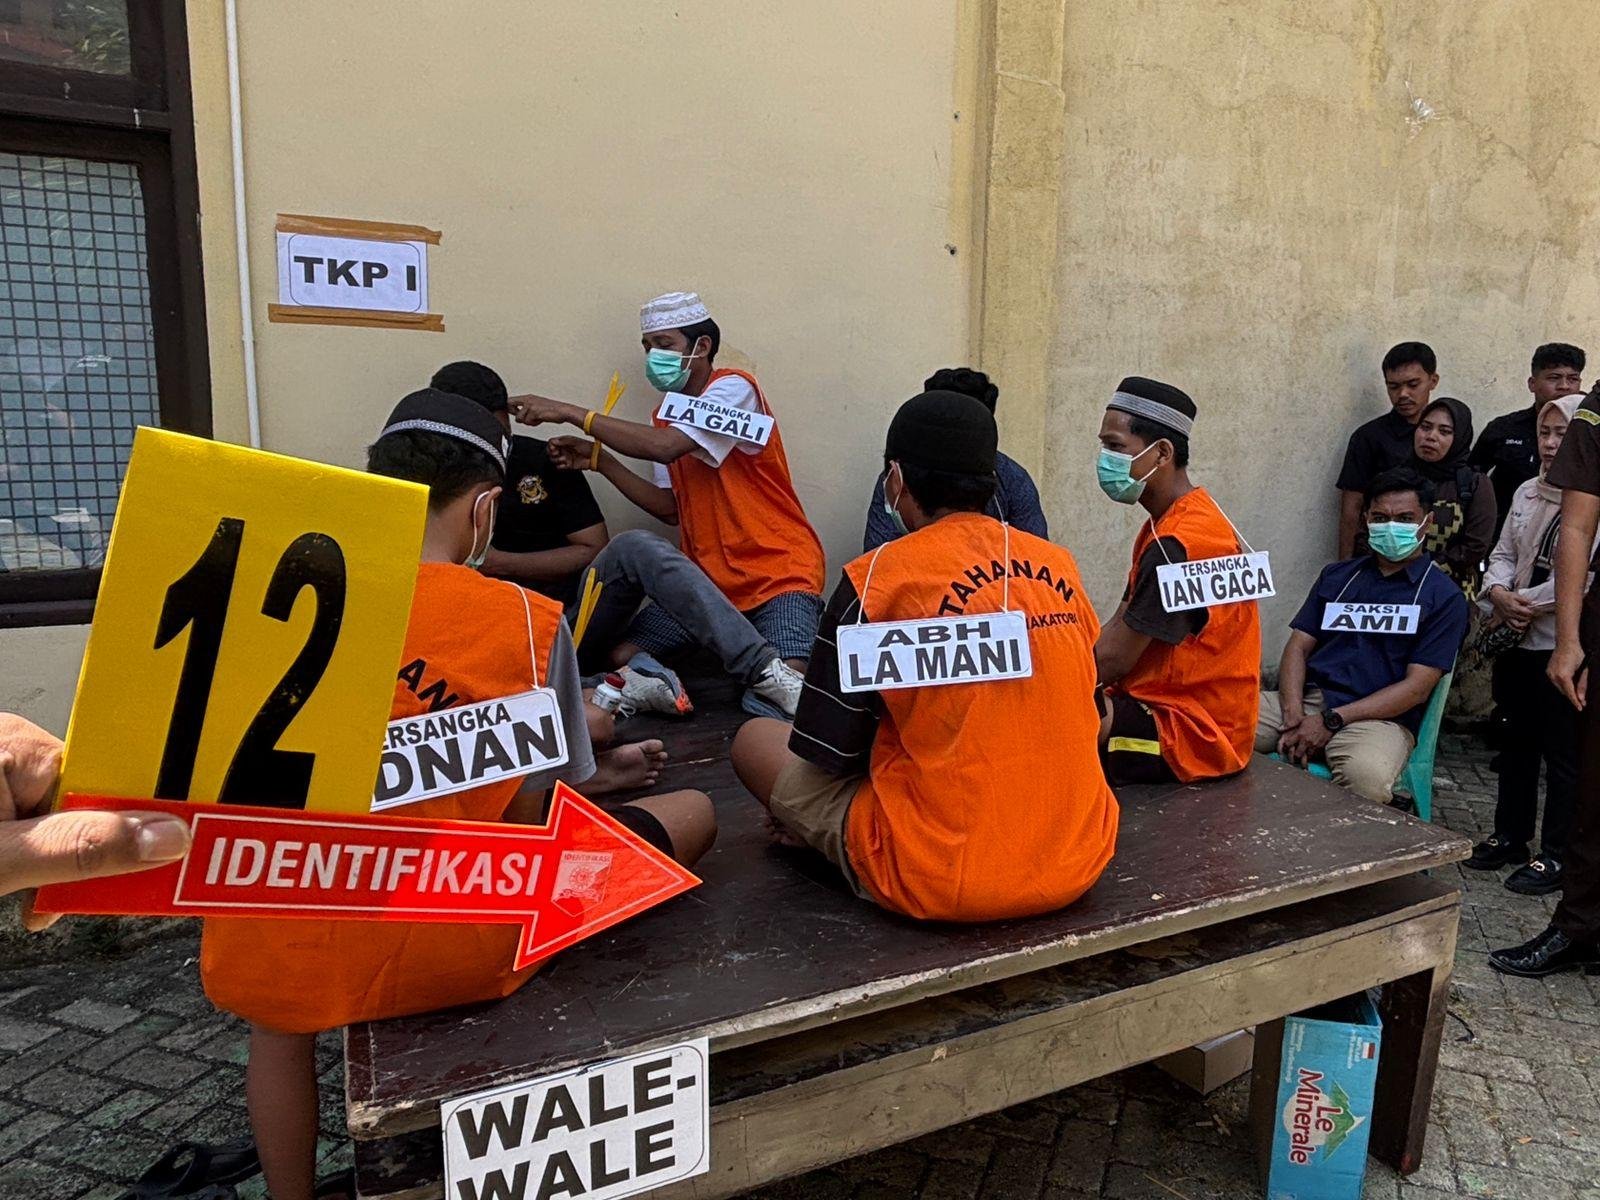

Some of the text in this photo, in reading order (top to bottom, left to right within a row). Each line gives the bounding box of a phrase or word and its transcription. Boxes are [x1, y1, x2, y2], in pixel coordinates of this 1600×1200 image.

[293, 255, 417, 291] TKP I
[664, 404, 765, 442] LA GALI
[687, 399, 752, 423] TERSANGKA
[938, 559, 1075, 616] TAHANAN
[1162, 567, 1272, 608] IAN GACA
[1181, 555, 1251, 578] TERSANGKA
[1328, 614, 1409, 632] AMI
[1342, 603, 1400, 614] SAKSI
[877, 621, 992, 648] ABH
[153, 516, 347, 810] 12
[848, 638, 1021, 687] LA MANI
[382, 702, 513, 750] RSANGKA
[373, 714, 560, 803] DNAN
[204, 837, 543, 898] IDENTIFIKASI
[456, 1056, 696, 1161] WALE-
[1290, 1068, 1323, 1164] Minerale
[1315, 1103, 1342, 1134] Le
[456, 1119, 676, 1200] WALE
